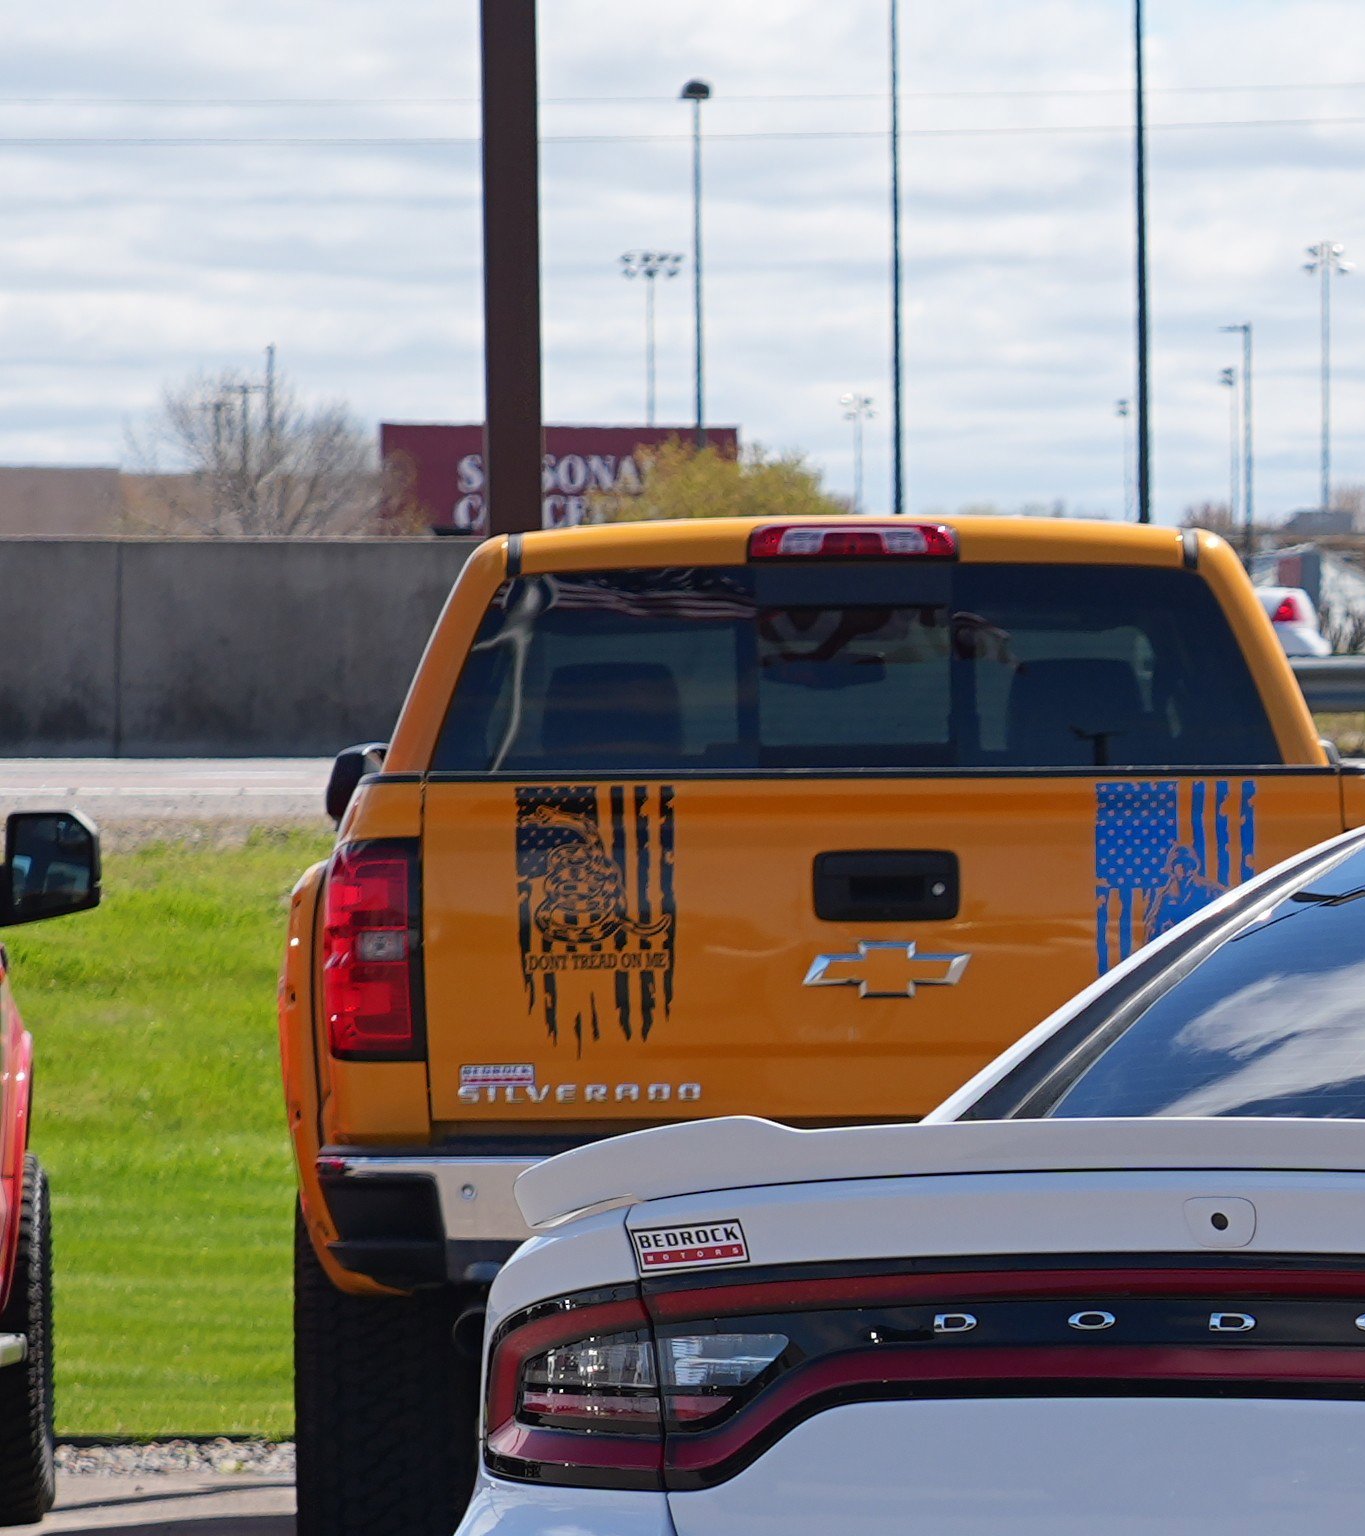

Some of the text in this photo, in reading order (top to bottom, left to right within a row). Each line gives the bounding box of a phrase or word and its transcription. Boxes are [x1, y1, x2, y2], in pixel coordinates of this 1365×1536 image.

[528, 952, 667, 970] DONT TREAD ON ME
[457, 1083, 702, 1104] SILVERADO
[638, 1225, 741, 1249] BEDROCK
[646, 1246, 740, 1262] MOTORS
